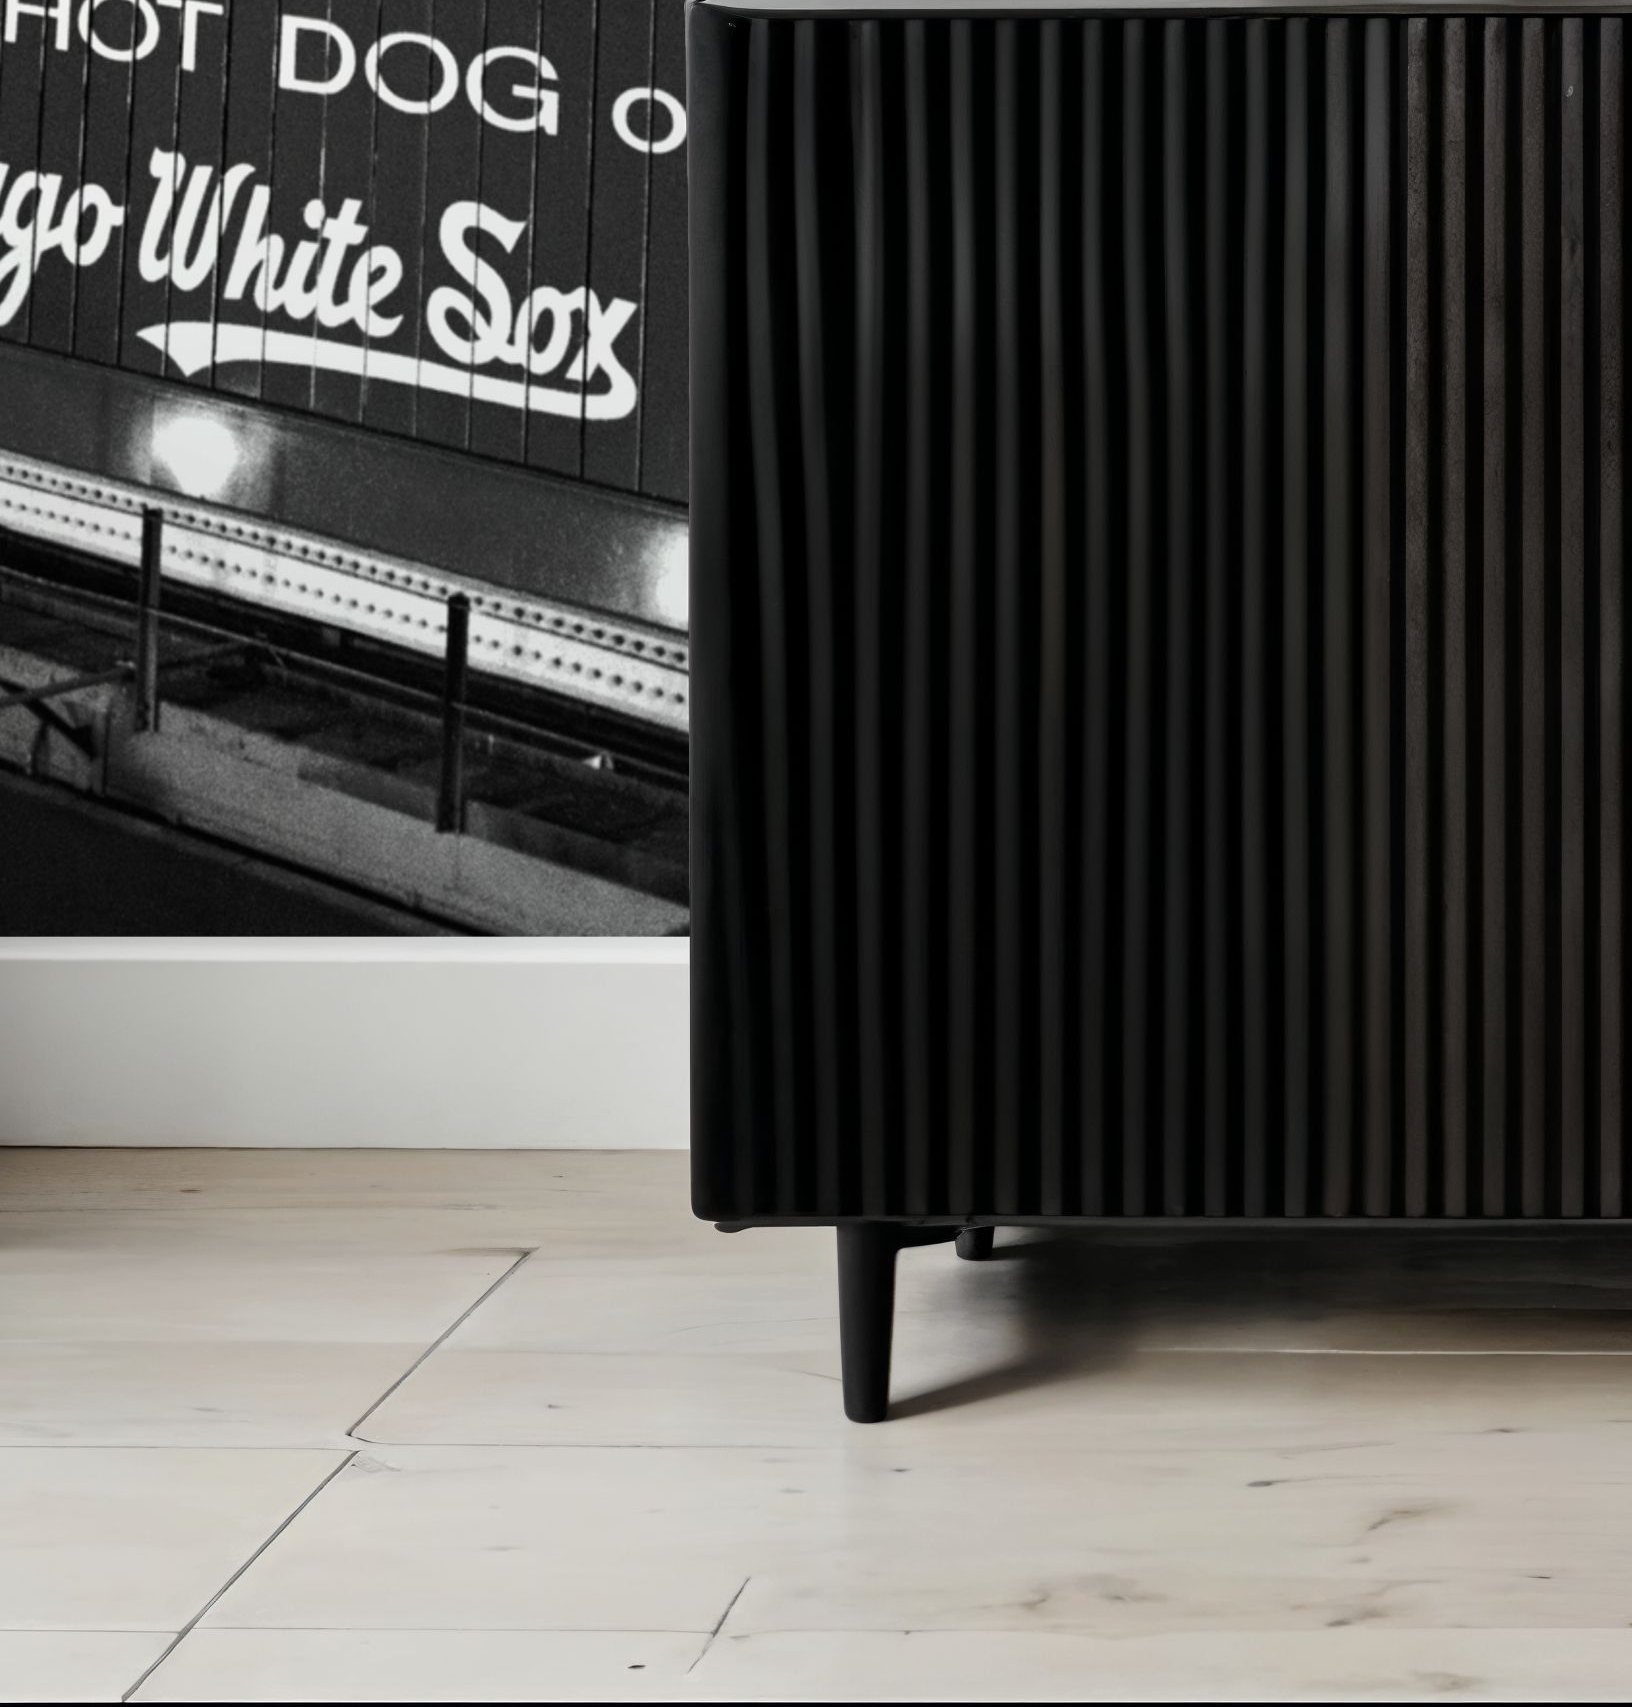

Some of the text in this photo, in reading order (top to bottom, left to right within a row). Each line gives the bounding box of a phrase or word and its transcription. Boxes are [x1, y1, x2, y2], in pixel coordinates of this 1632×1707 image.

[279, 14, 560, 136] DOG
[138, 147, 404, 337] White
[427, 201, 638, 402] Sox
